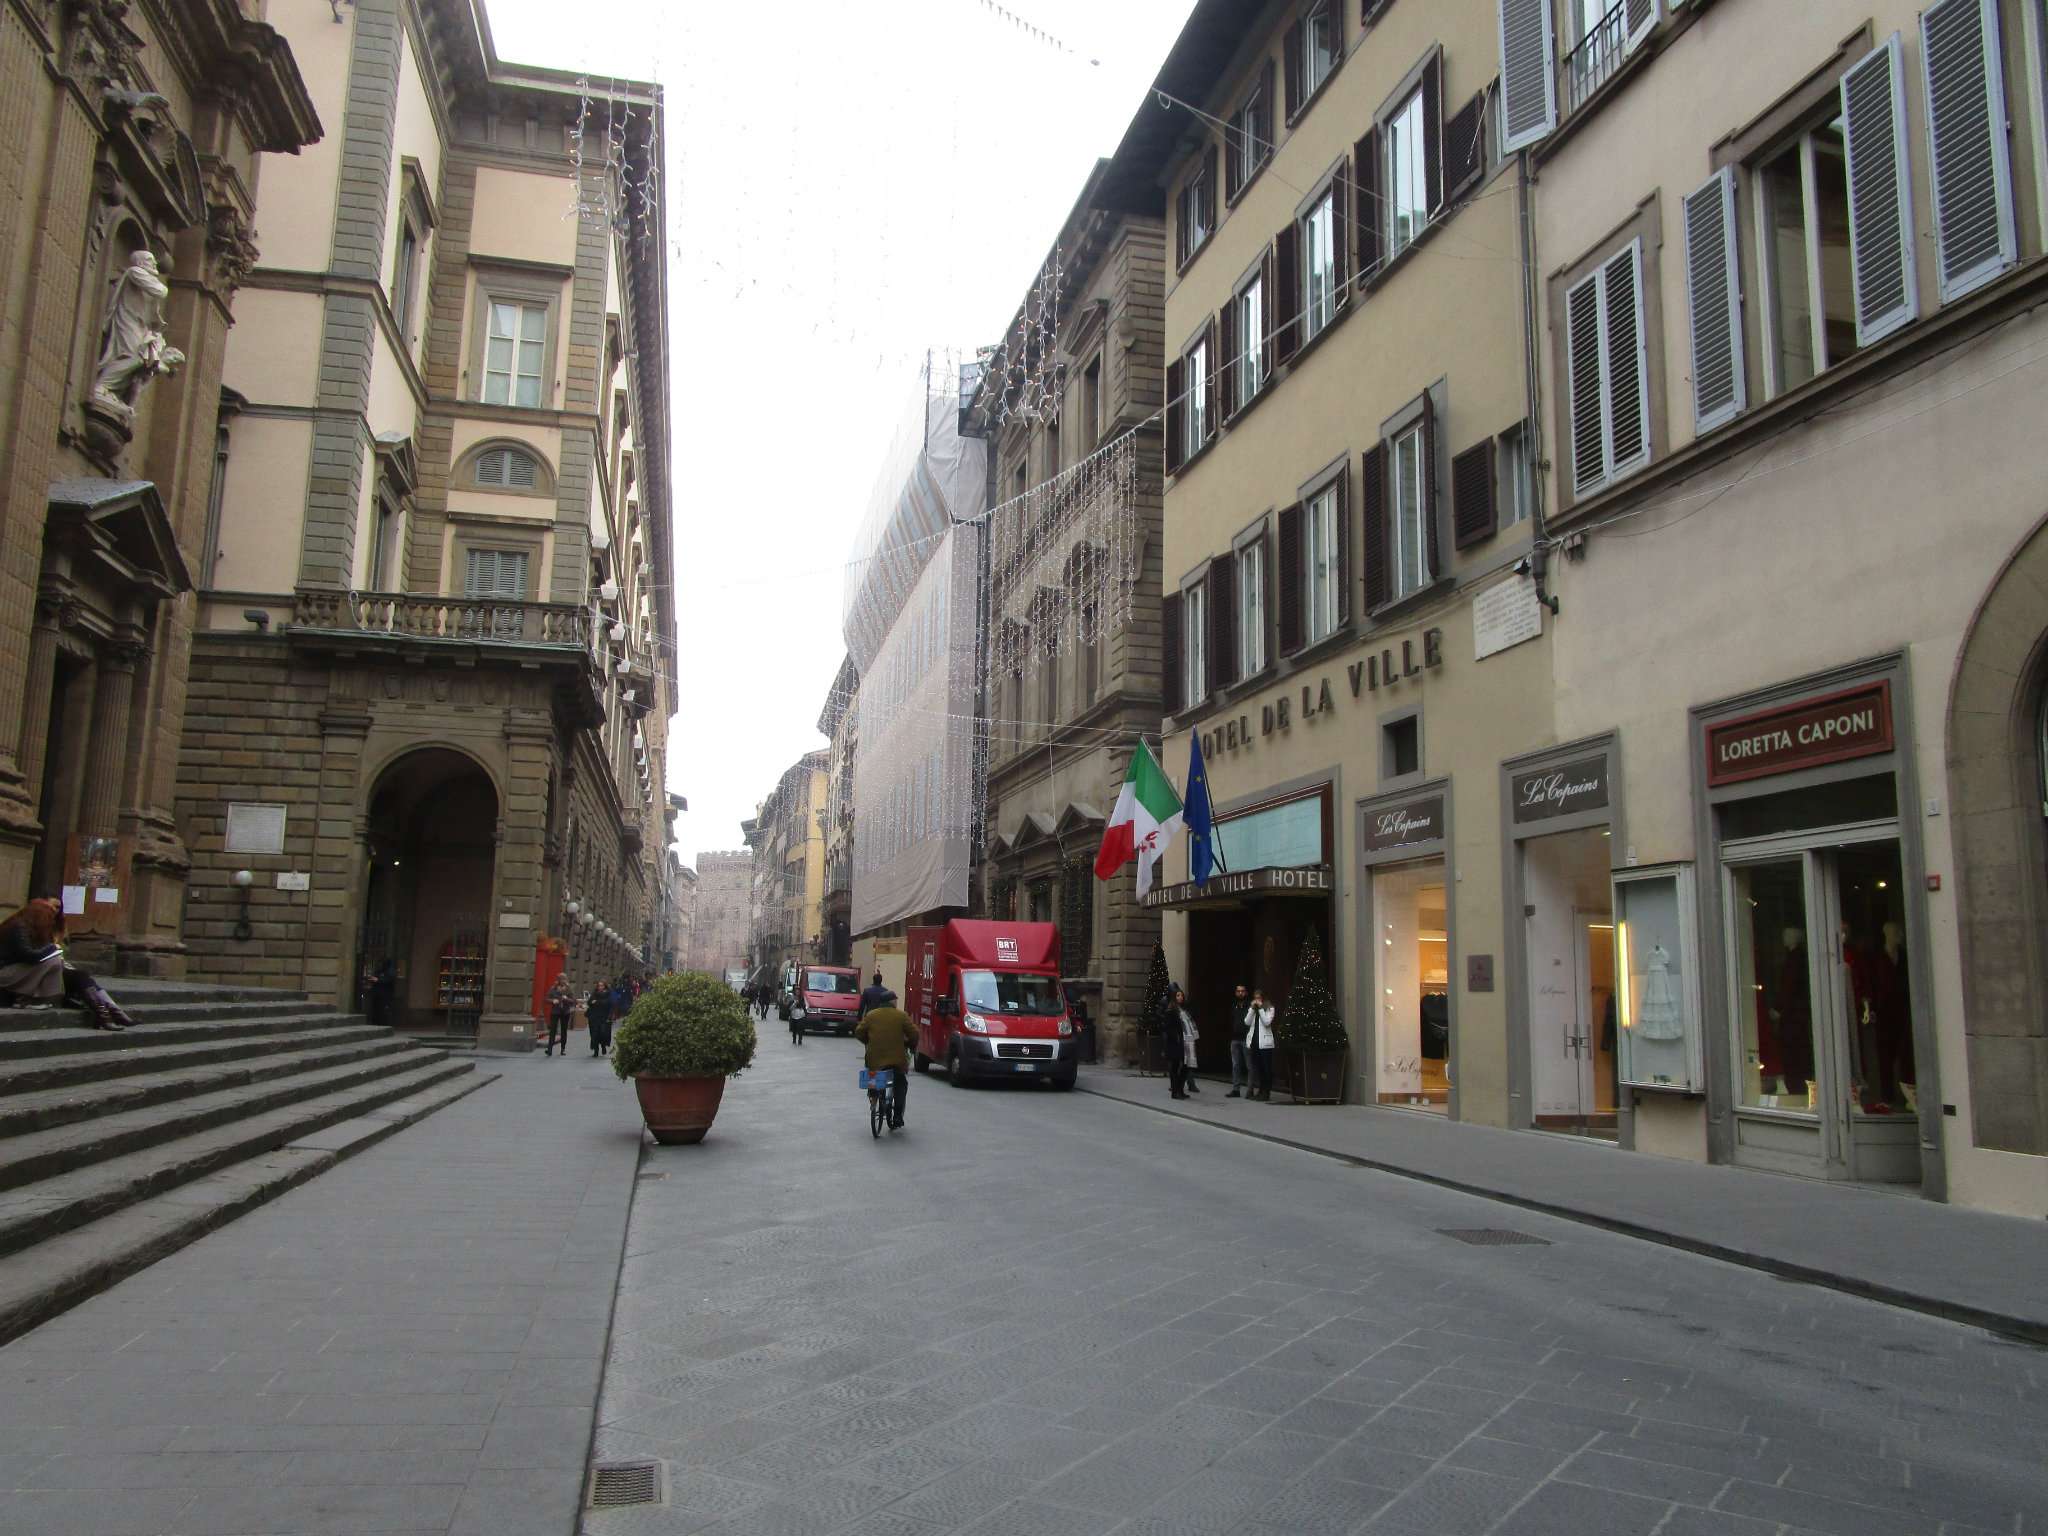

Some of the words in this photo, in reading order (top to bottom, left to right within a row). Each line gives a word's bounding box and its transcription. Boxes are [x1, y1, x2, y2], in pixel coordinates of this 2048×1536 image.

[1202, 715, 1252, 760] OTEL
[1262, 696, 1290, 737] DE
[1302, 678, 1335, 719] LA
[1348, 628, 1442, 698] VILLE
[1720, 729, 1793, 762] LORETTA
[1797, 709, 1874, 745] CAPONI
[1519, 778, 1544, 807] Les
[1543, 773, 1599, 808] Copains
[1374, 814, 1393, 837] Les
[1392, 808, 1431, 839] Copains
[1147, 889, 1173, 906] HOTEL
[1181, 884, 1192, 900] DE
[1222, 873, 1254, 893] VILLE
[1272, 870, 1329, 888] HOTEL
[998, 940, 1015, 949] BRT
